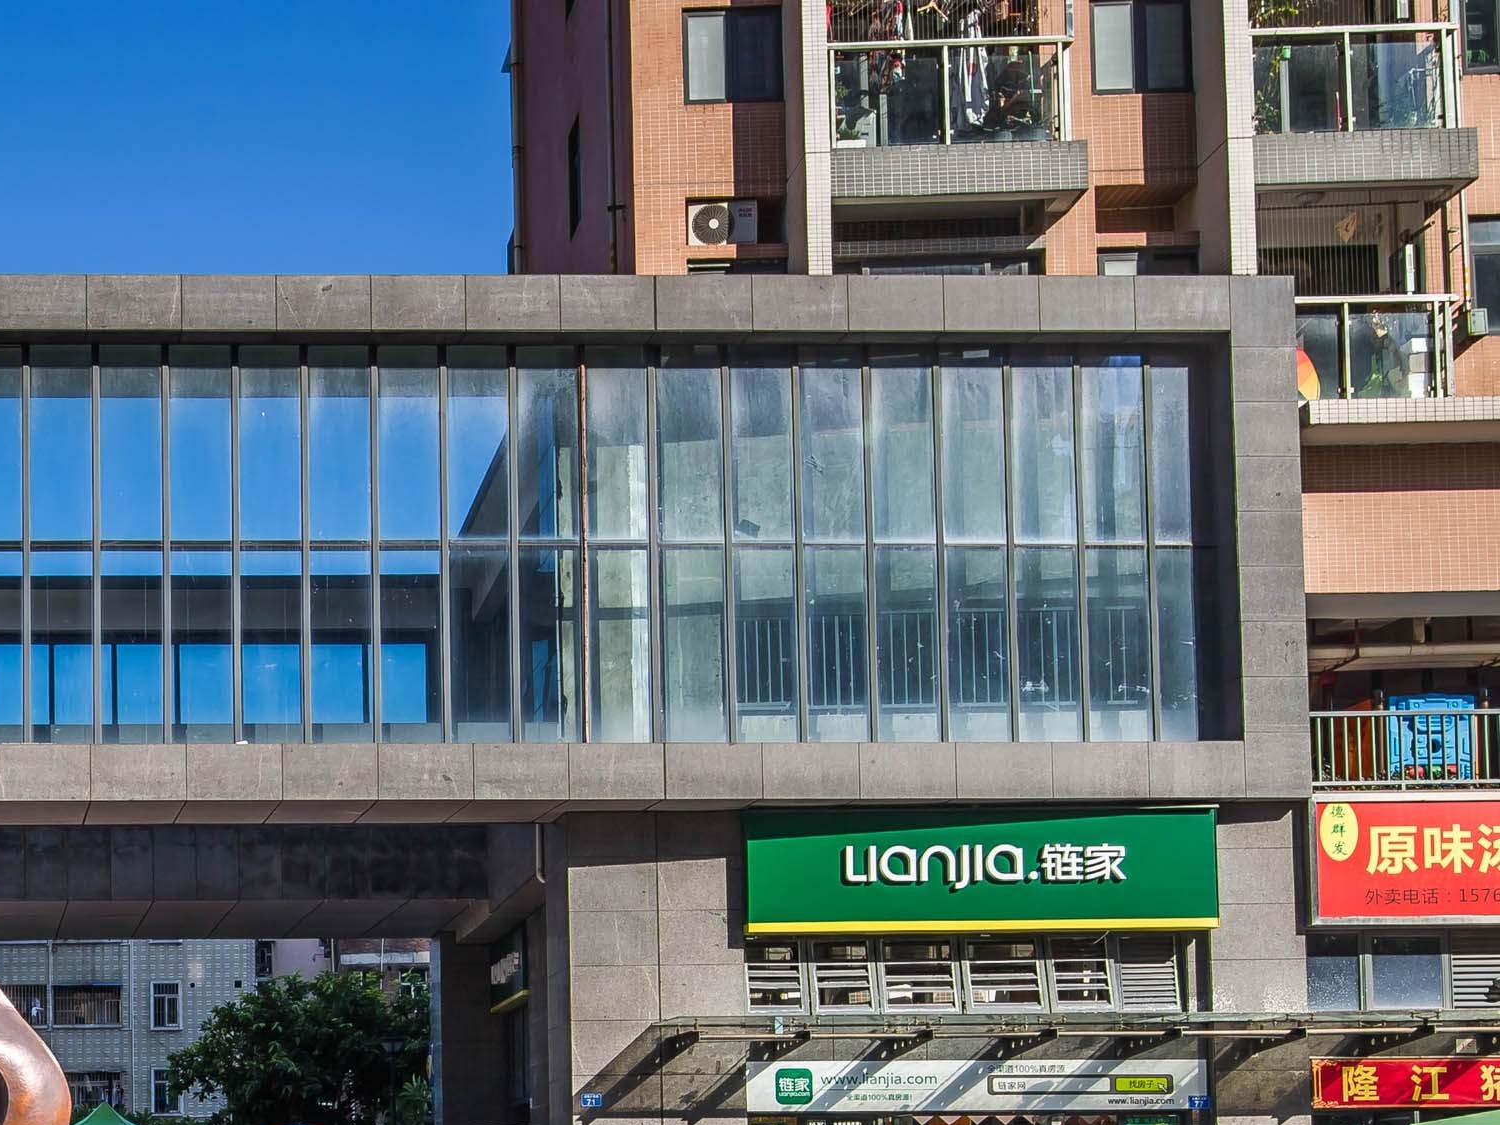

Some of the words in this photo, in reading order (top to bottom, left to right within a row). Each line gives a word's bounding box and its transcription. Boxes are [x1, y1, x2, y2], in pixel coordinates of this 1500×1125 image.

[778, 1077, 810, 1092] 链家
[820, 1072, 938, 1088] www.lianjia.com
[1128, 1080, 1155, 1089] 找房子
[998, 1081, 1026, 1090] 链家网
[1108, 1096, 1175, 1106] www.lianjia.com
